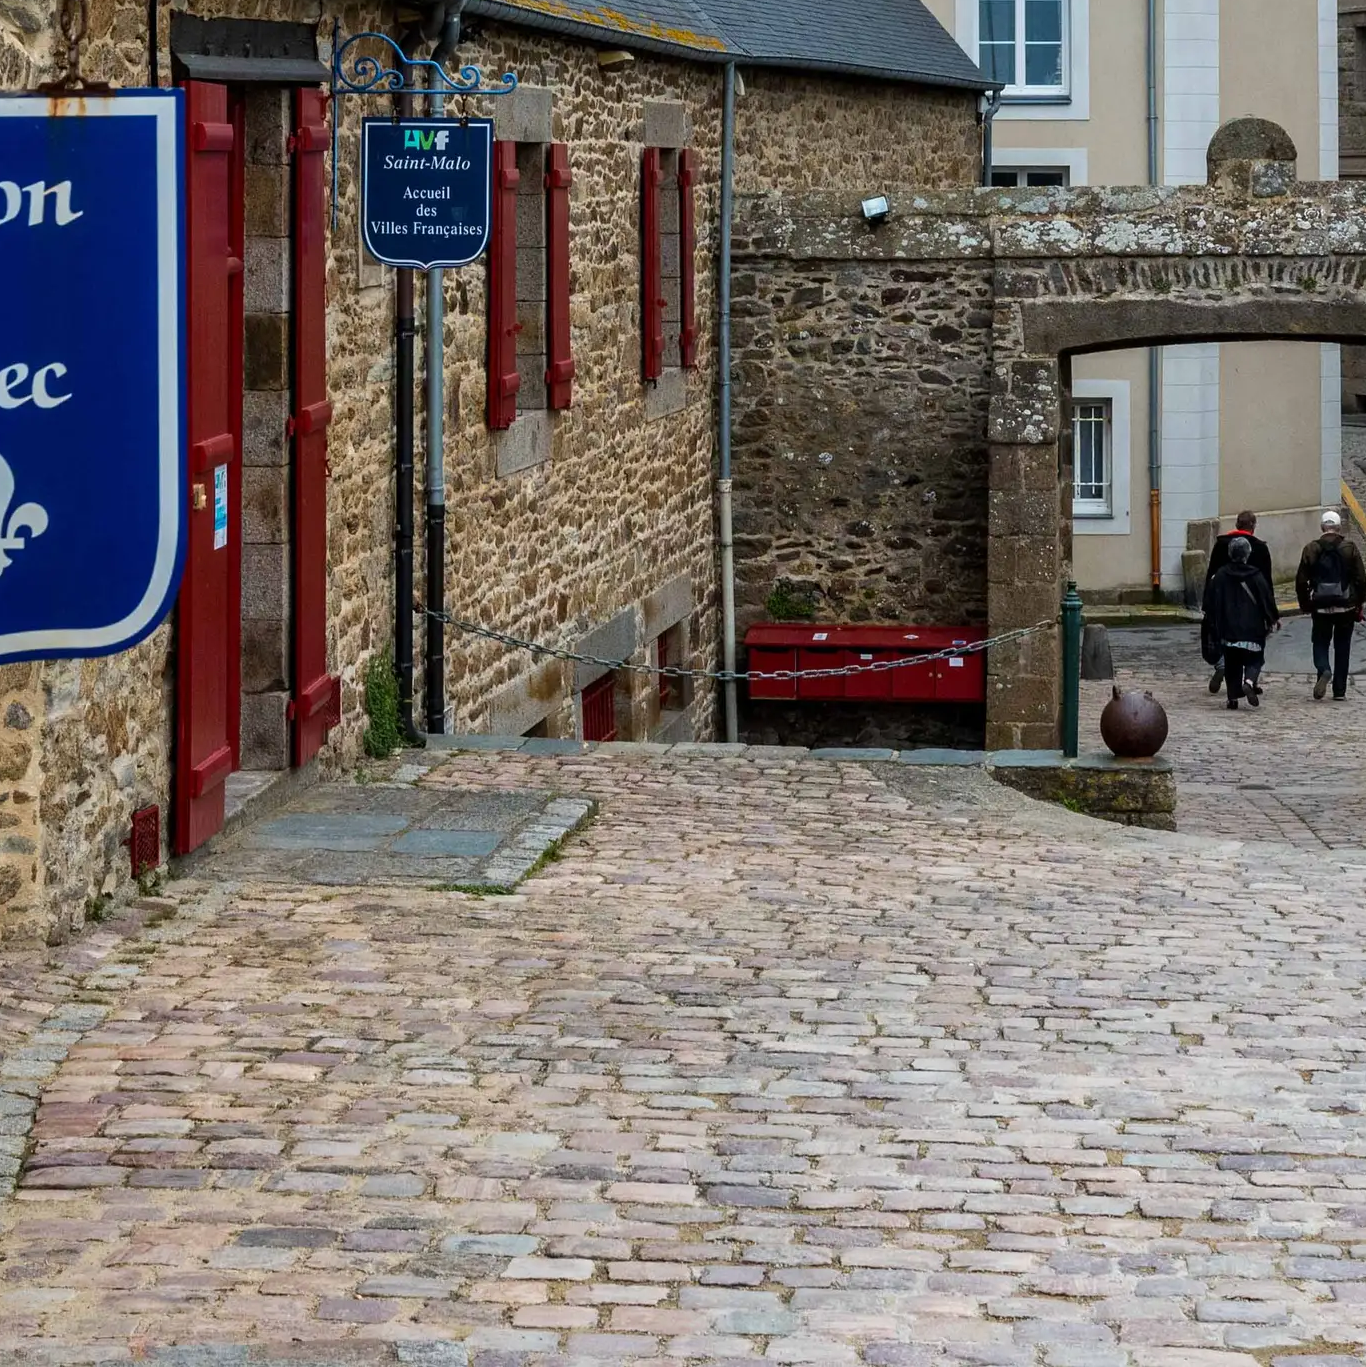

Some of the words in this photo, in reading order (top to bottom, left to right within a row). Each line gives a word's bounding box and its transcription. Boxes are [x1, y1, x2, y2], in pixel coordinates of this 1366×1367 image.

[383, 154, 471, 171] Saint-Malo
[402, 185, 451, 200] Accueil
[415, 203, 438, 218] des
[371, 220, 408, 235] Villes
[412, 221, 483, 239] Françaises
